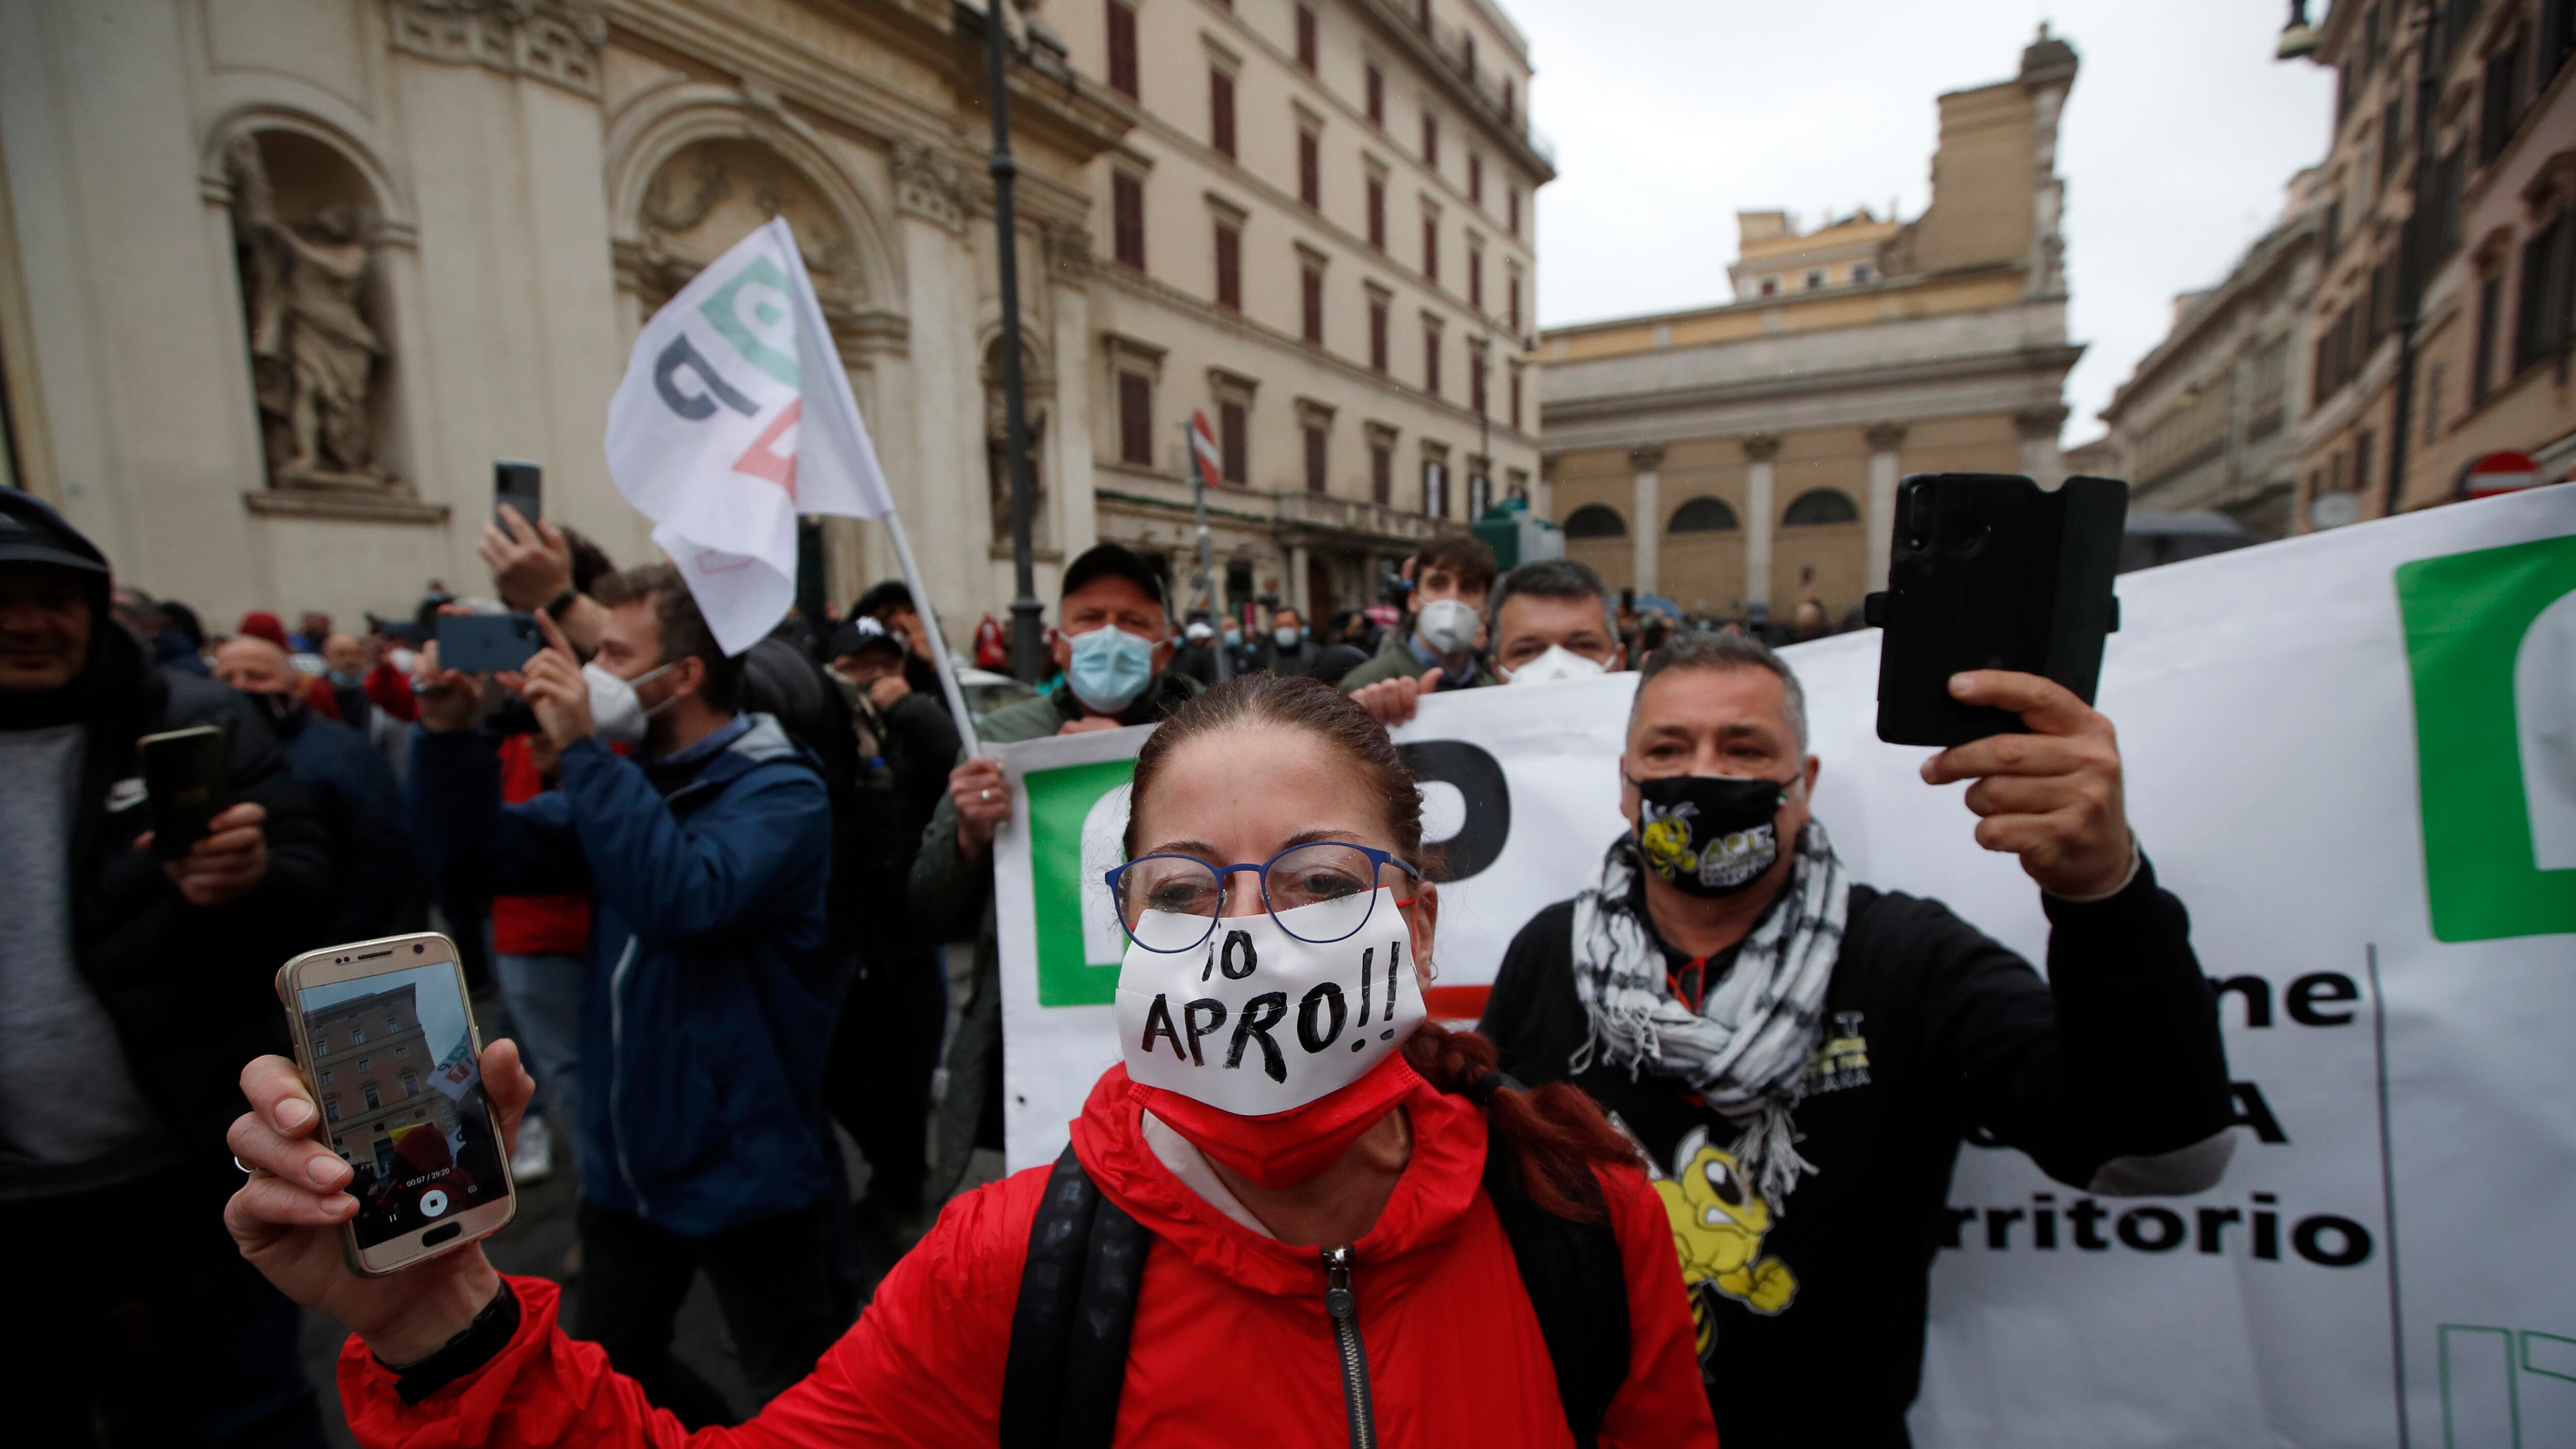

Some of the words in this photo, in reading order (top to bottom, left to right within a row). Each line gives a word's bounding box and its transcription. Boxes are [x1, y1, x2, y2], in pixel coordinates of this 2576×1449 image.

[1202, 920, 1257, 982] IO
[1141, 941, 1400, 1084] APRO!!
[406, 1175, 425, 1187] 00:07
[431, 1168, 450, 1179] 29:20
